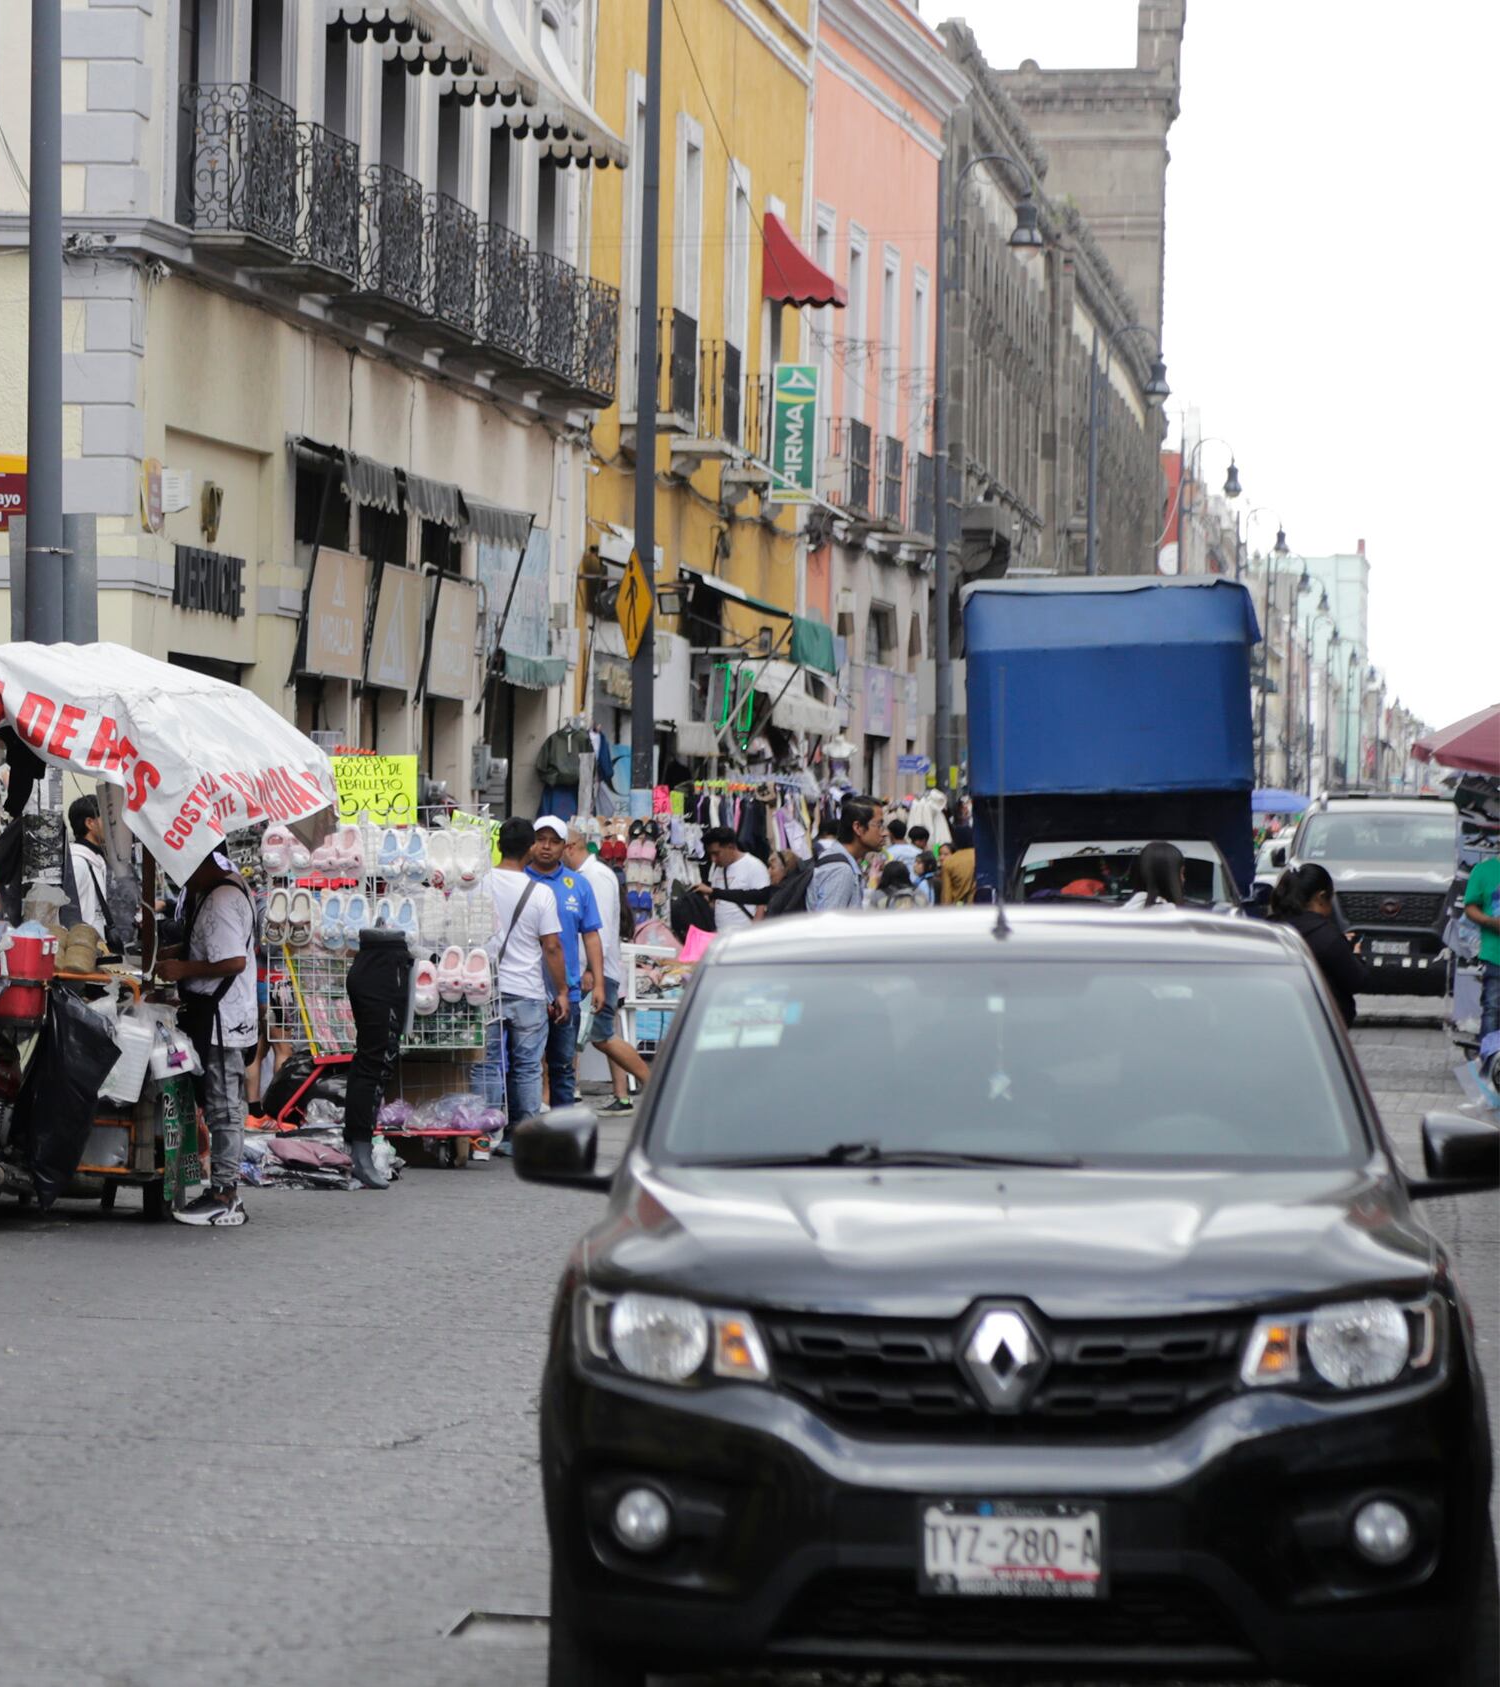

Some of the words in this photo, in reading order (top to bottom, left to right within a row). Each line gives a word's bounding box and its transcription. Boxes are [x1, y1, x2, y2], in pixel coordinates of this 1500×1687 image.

[783, 404, 805, 490] PIRMA
[173, 545, 246, 620] VERTICHE
[16, 692, 86, 760] DE
[334, 763, 384, 778] BOXER
[388, 763, 403, 776] DE
[340, 792, 411, 817] 5x50
[925, 1524, 1099, 1567] TYZ-280-A
